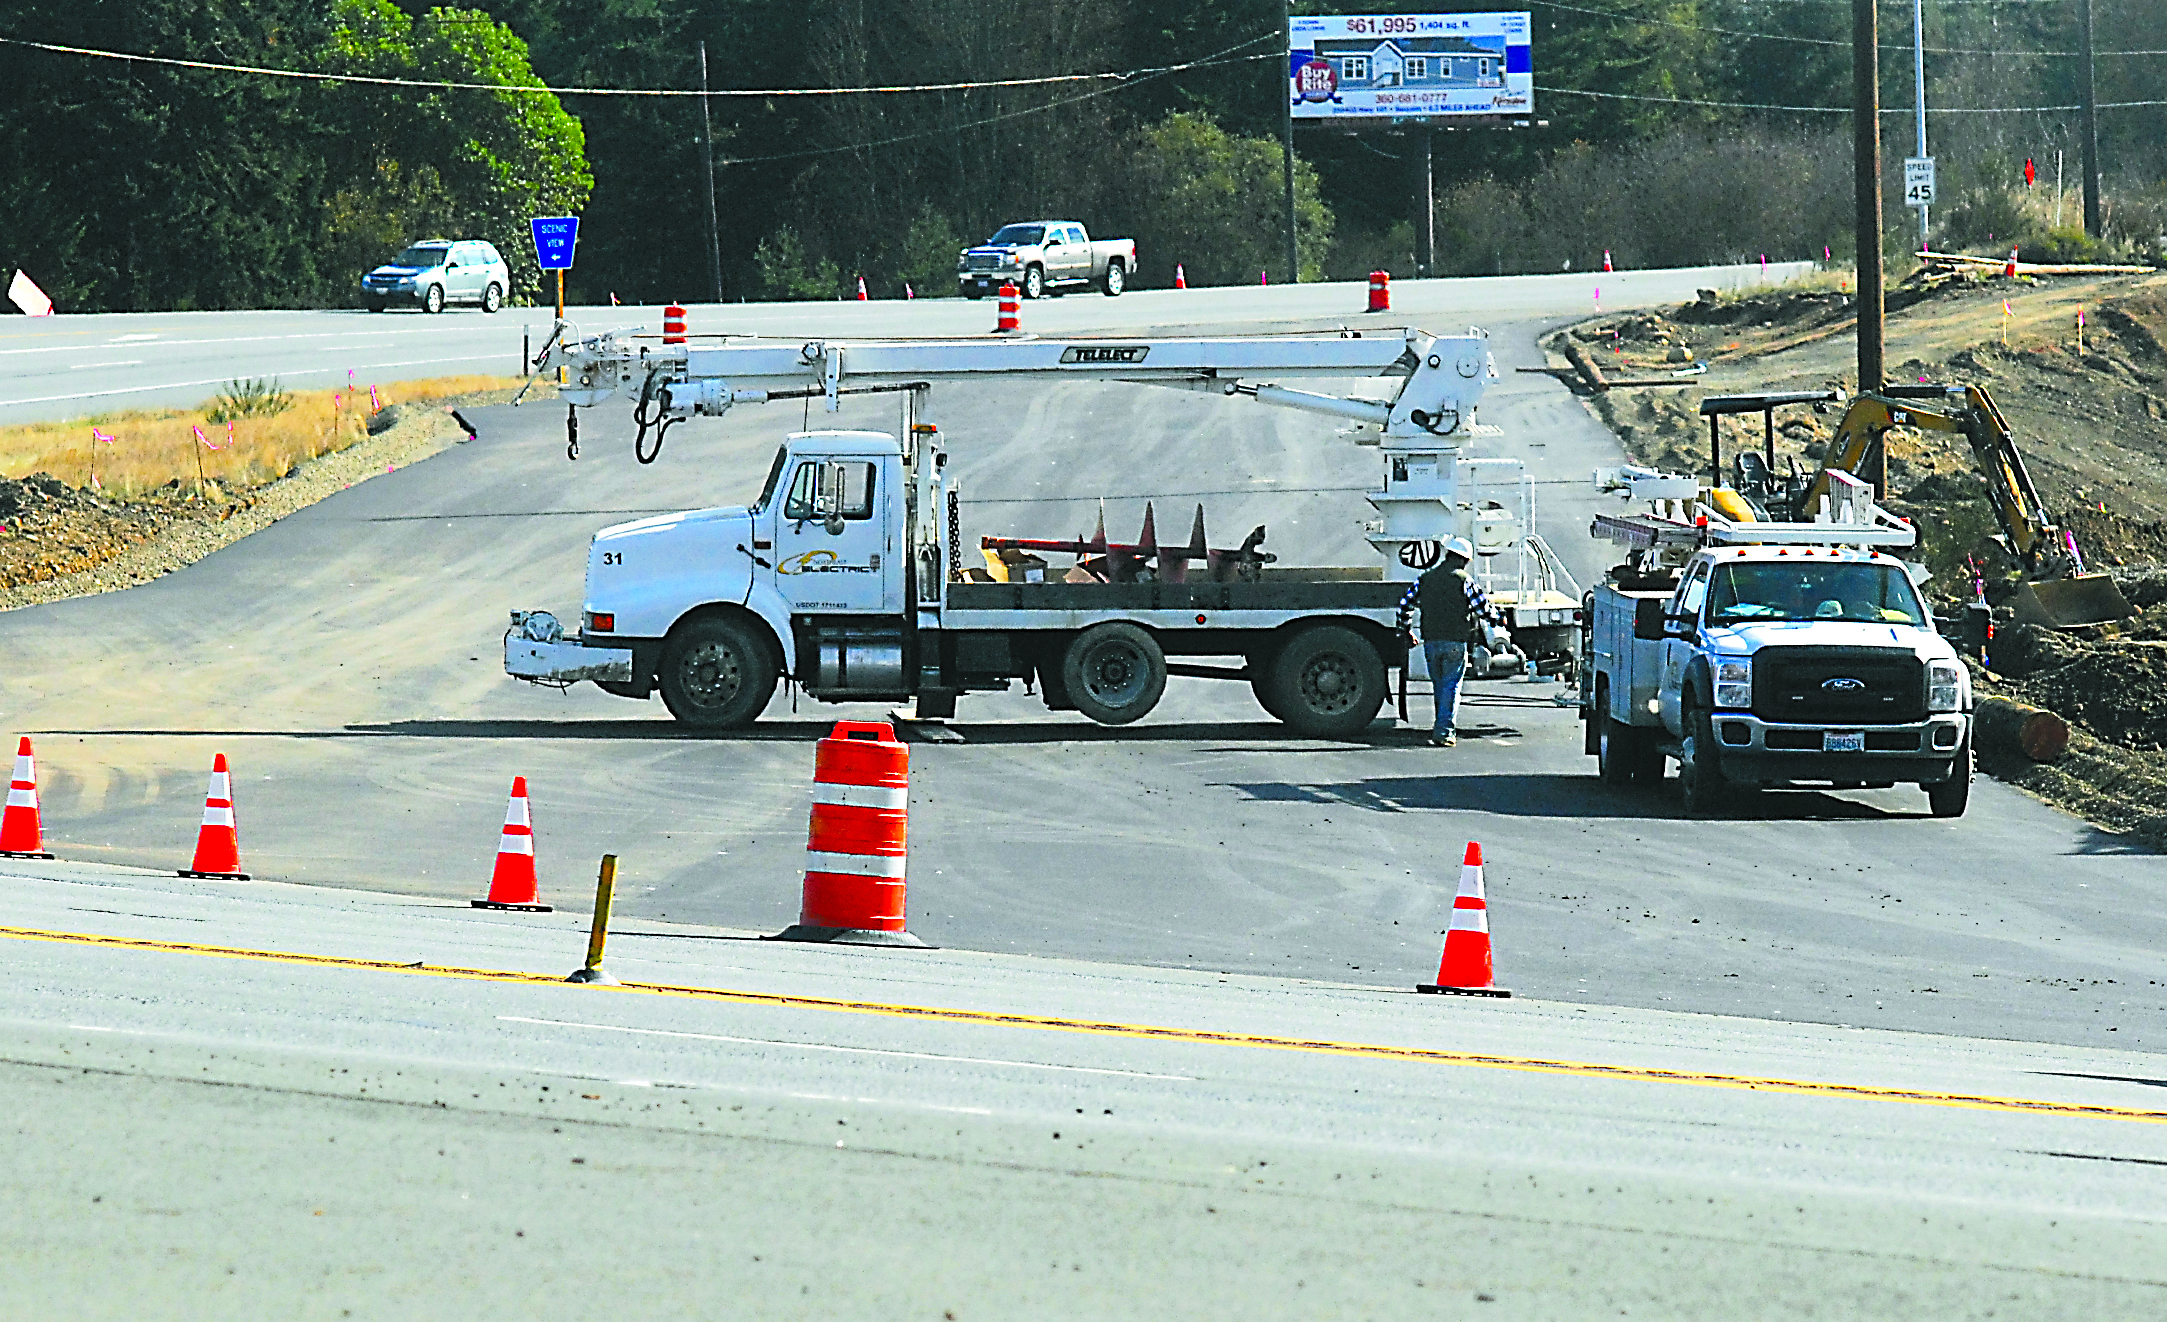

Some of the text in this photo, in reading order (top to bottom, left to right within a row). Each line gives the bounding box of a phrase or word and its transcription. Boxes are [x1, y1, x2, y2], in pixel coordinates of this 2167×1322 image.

[1346, 17, 1416, 35] $61,995
[1301, 65, 1331, 80] Buy
[1302, 78, 1332, 91] Rite
[1908, 185, 1931, 200] 45
[541, 224, 567, 233] SCENIC
[547, 238, 564, 247] VIEW
[1076, 349, 1138, 361] TELELECT
[1894, 411, 1907, 423] CAT
[603, 552, 622, 565] 31
[801, 565, 870, 573] ELECTRIC
